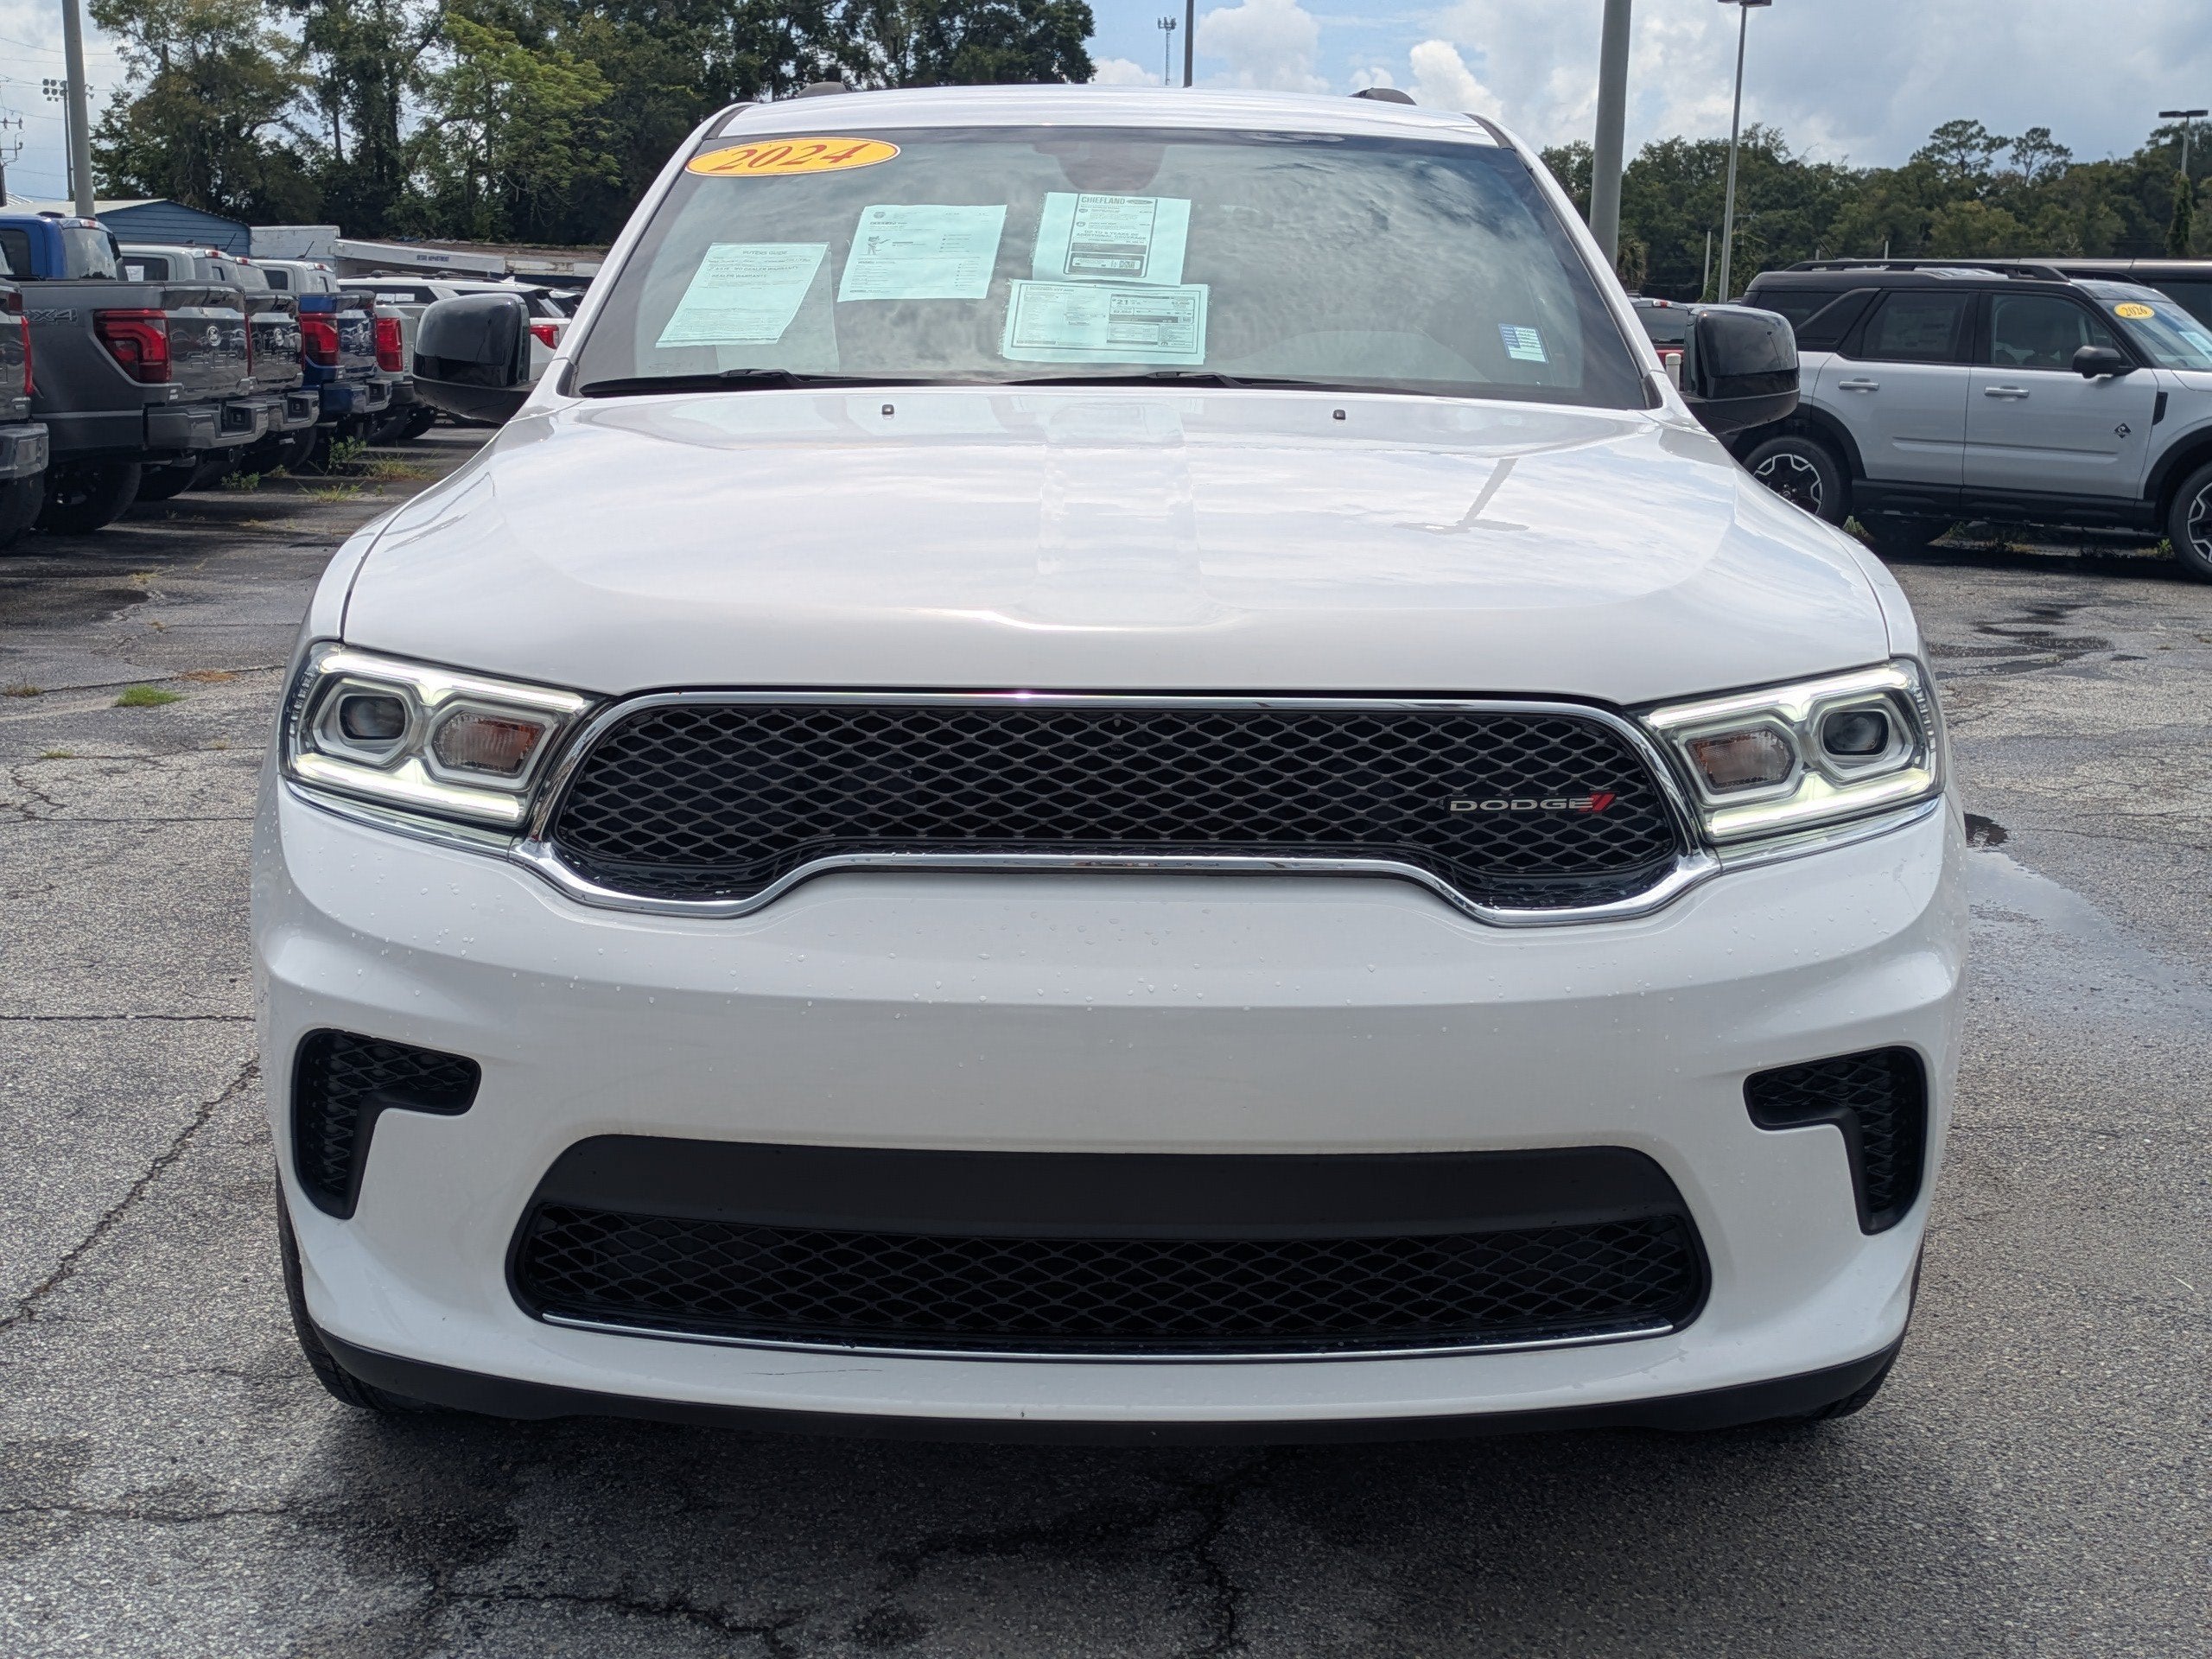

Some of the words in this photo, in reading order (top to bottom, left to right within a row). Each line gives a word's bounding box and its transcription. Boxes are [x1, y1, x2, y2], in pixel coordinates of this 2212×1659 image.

[708, 143, 871, 171] 2024
[1081, 196, 1126, 206] CHIEFLAND
[2121, 307, 2148, 316] 2026
[1450, 798, 1594, 811] DODGE
